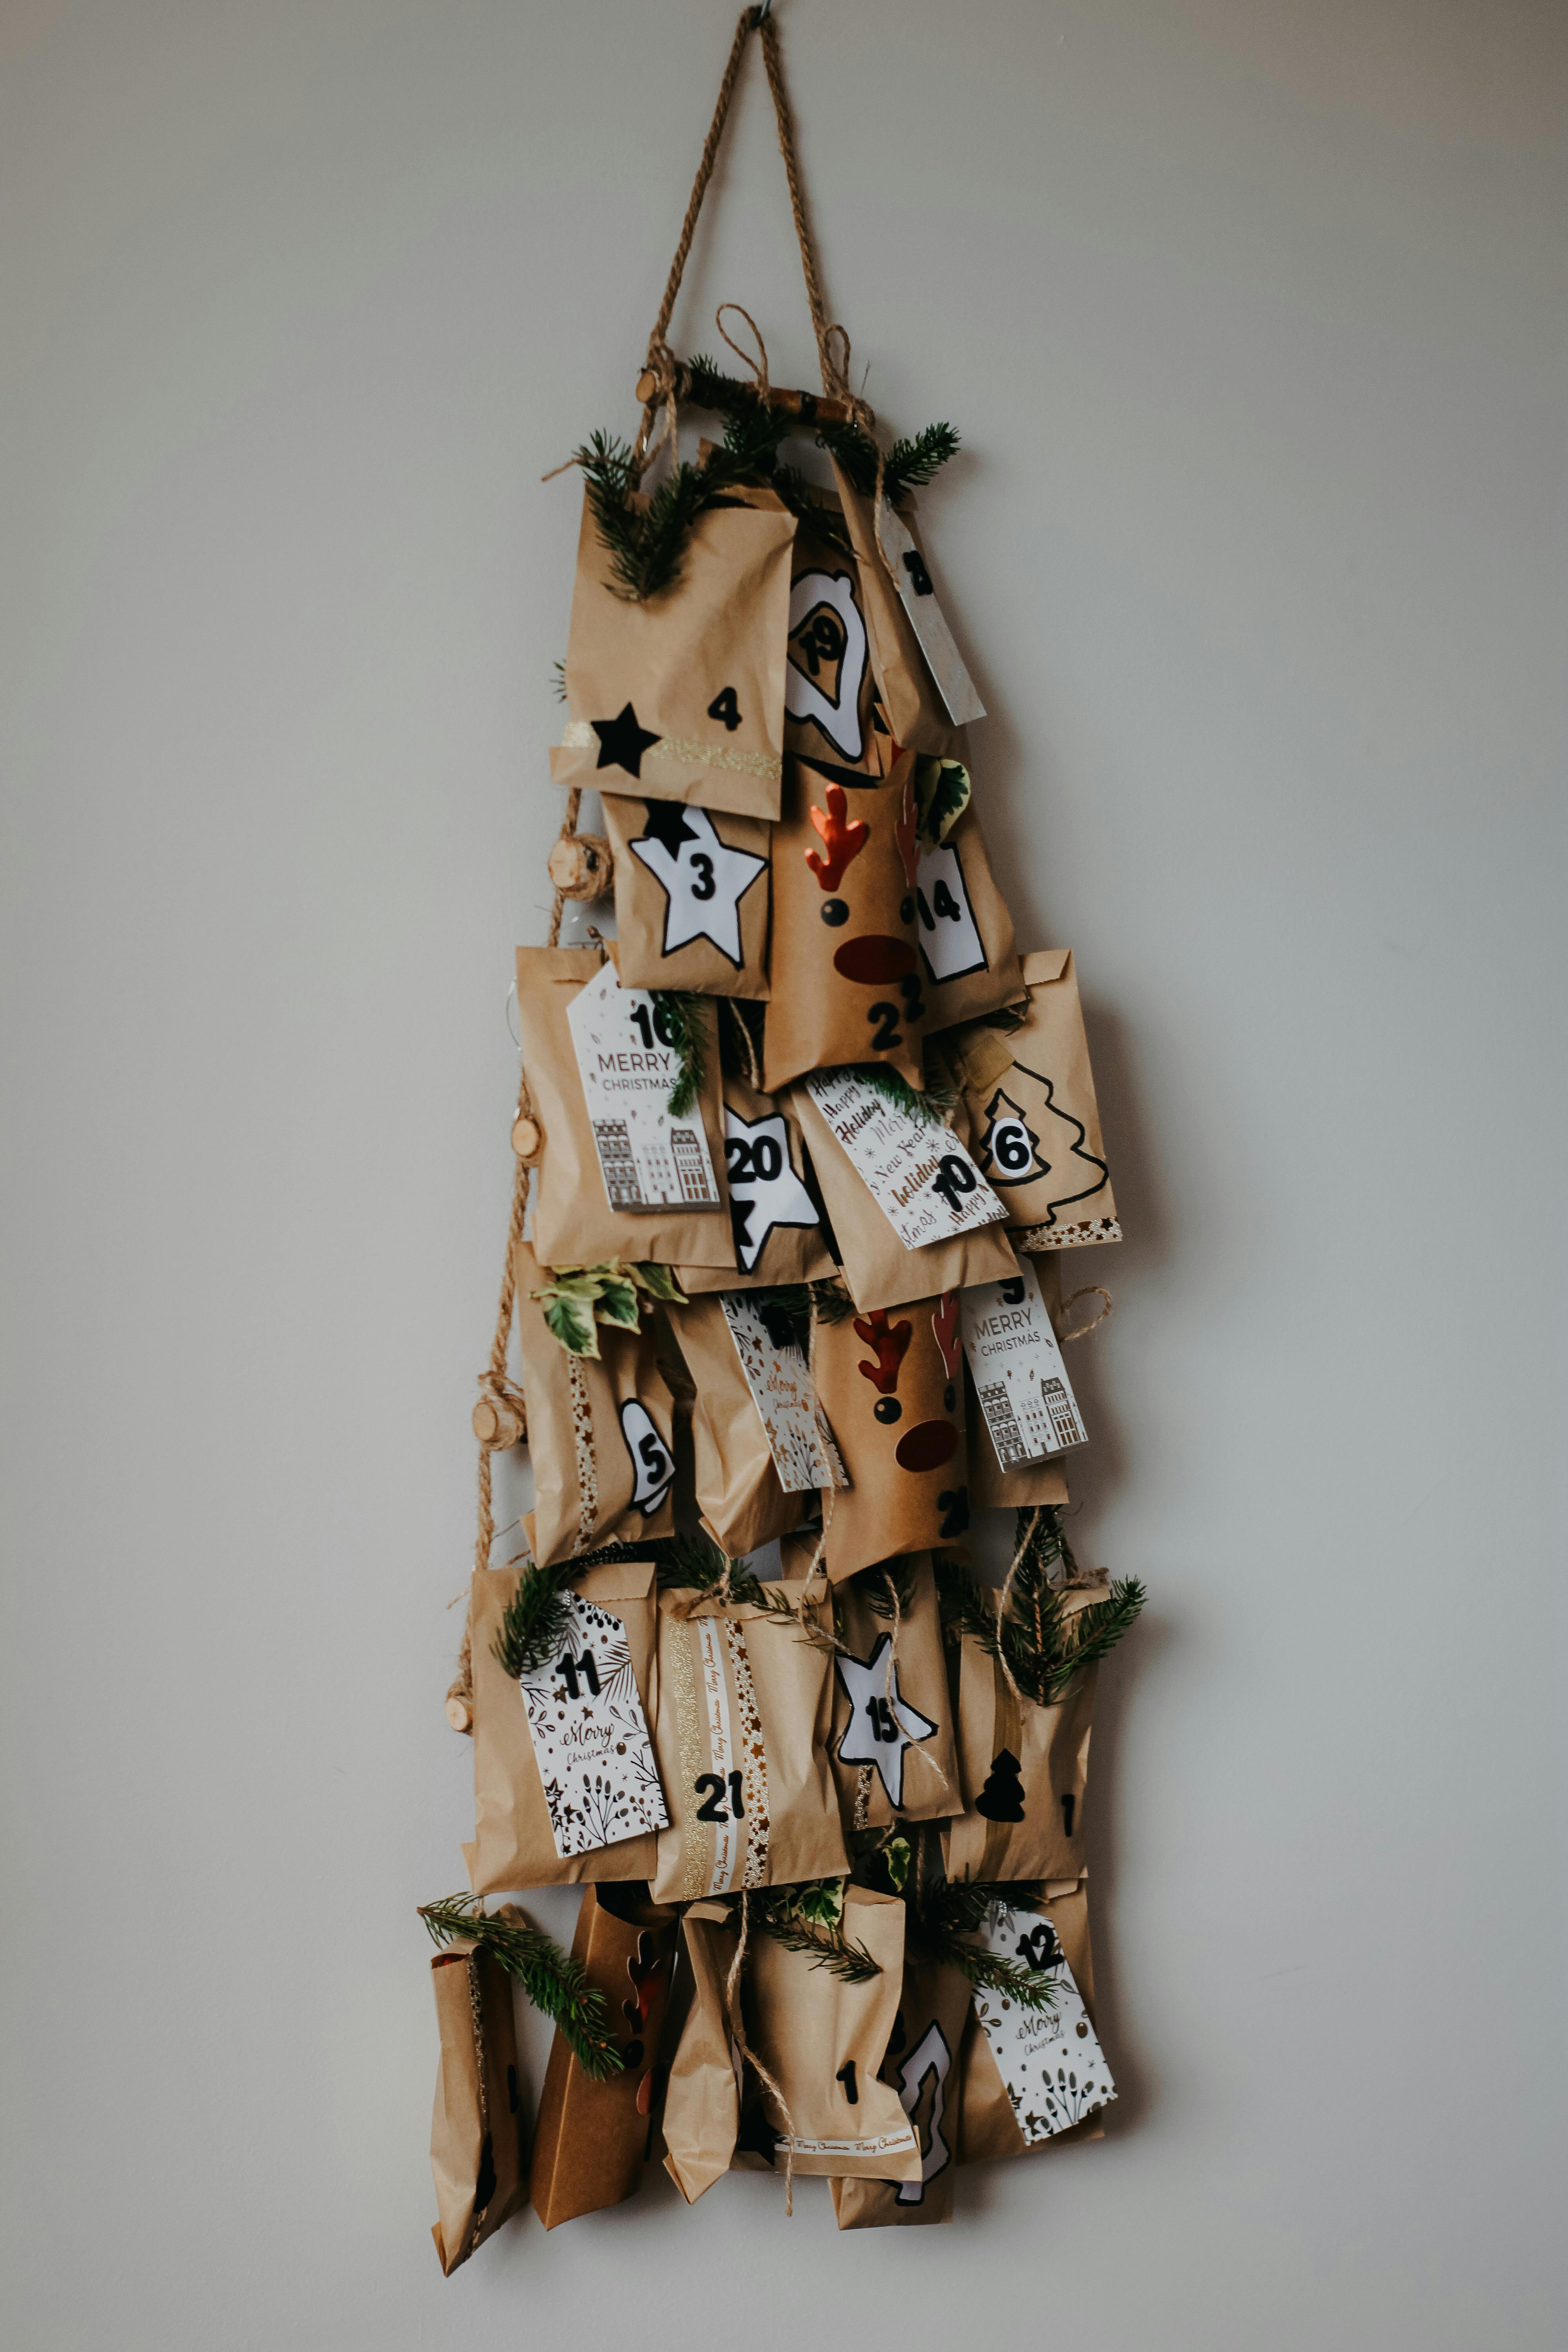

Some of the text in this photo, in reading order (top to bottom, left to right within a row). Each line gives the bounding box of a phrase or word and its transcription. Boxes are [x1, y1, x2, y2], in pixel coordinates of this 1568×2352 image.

[798, 615, 842, 676] 19
[708, 686, 743, 731] 4
[690, 853, 716, 900] 3
[598, 1052, 670, 1072] MERRY
[603, 1078, 677, 1091] CHRISTMAS
[835, 1098, 885, 1145] Holiday
[724, 1135, 782, 1184] 20
[874, 1154, 902, 1177] New
[995, 1125, 1030, 1170] 6
[931, 1154, 977, 1212] 10
[974, 1307, 1032, 1340] MERRY
[981, 1331, 1040, 1357] CHRISTMAS
[638, 1433, 667, 1485] 5
[555, 1649, 601, 1700] 11
[559, 1722, 615, 1748] Merry
[567, 1744, 616, 1765] Christmas
[695, 1769, 745, 1823] 21
[1015, 1924, 1065, 1970] 12
[836, 2060, 859, 2105] 1
